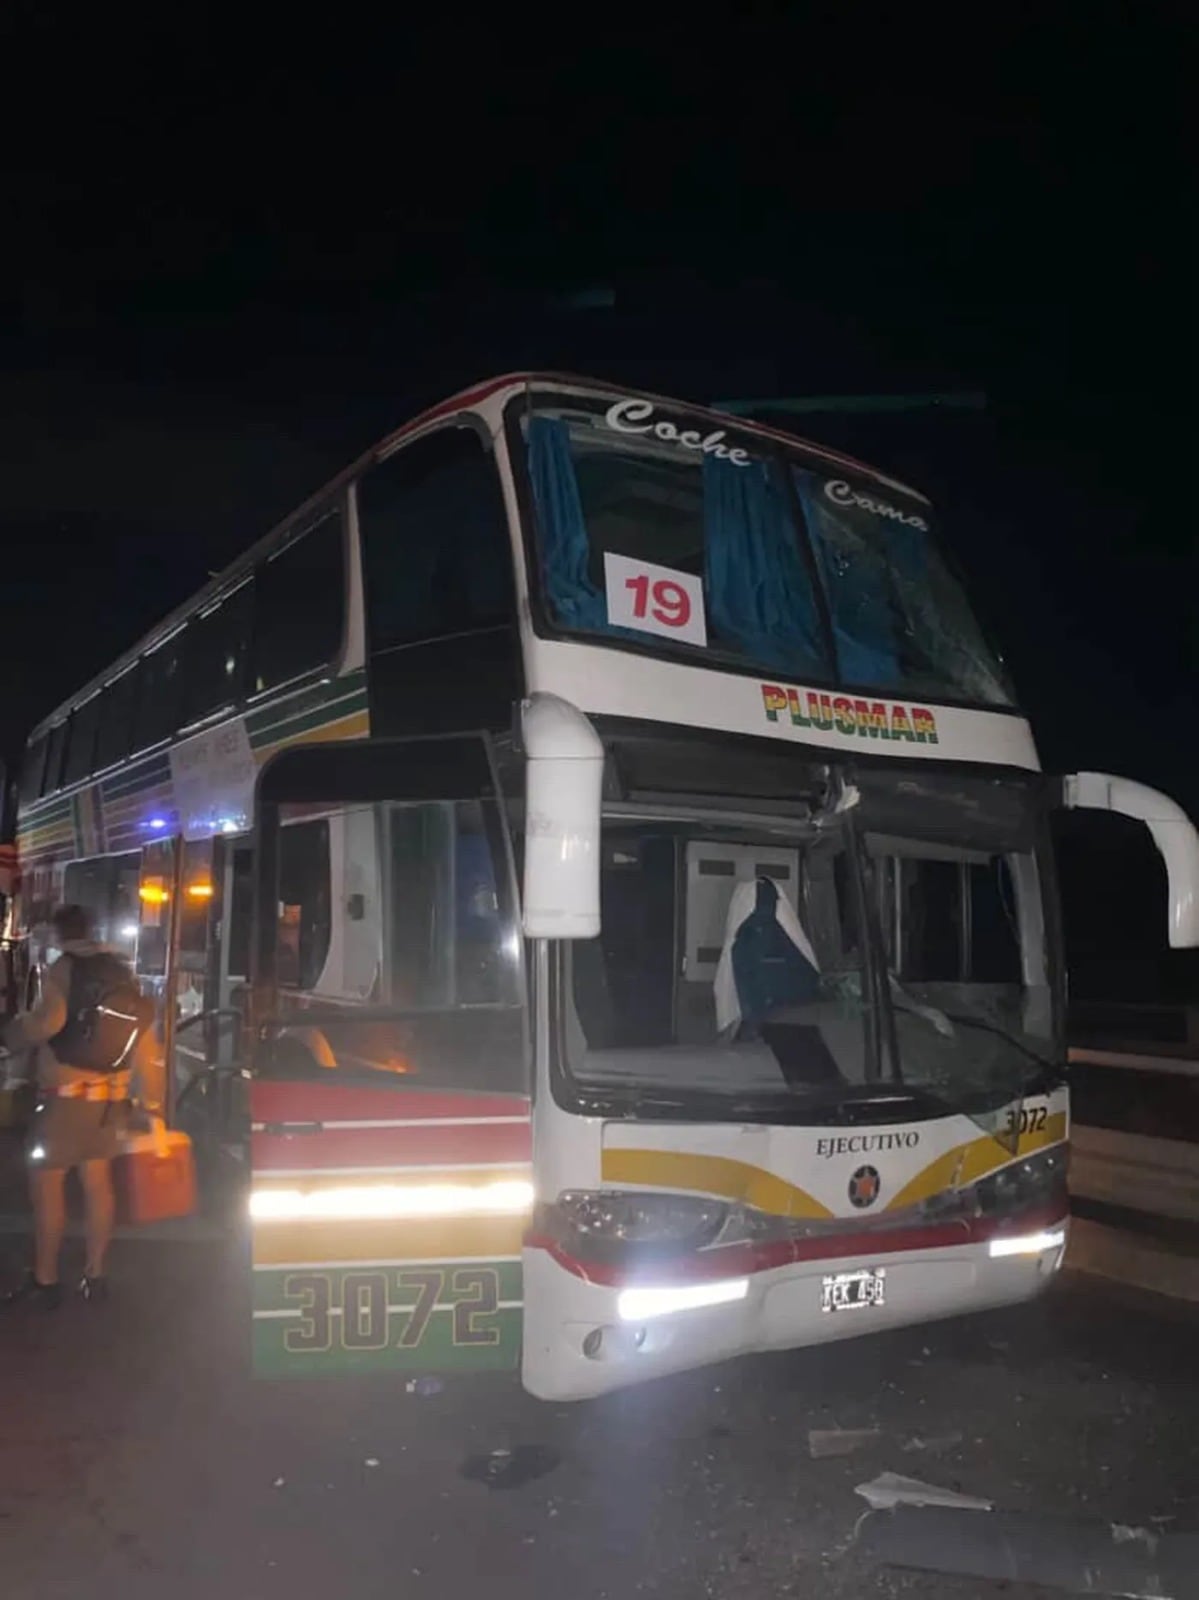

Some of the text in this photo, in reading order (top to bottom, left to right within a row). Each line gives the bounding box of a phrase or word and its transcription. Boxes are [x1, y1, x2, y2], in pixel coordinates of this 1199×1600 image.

[605, 399, 929, 532] Coche Cama
[625, 575, 691, 628] 19
[761, 684, 939, 744] PLUSMAR
[816, 1132, 920, 1158] EJECUTIVO
[284, 1268, 500, 1352] 3072
